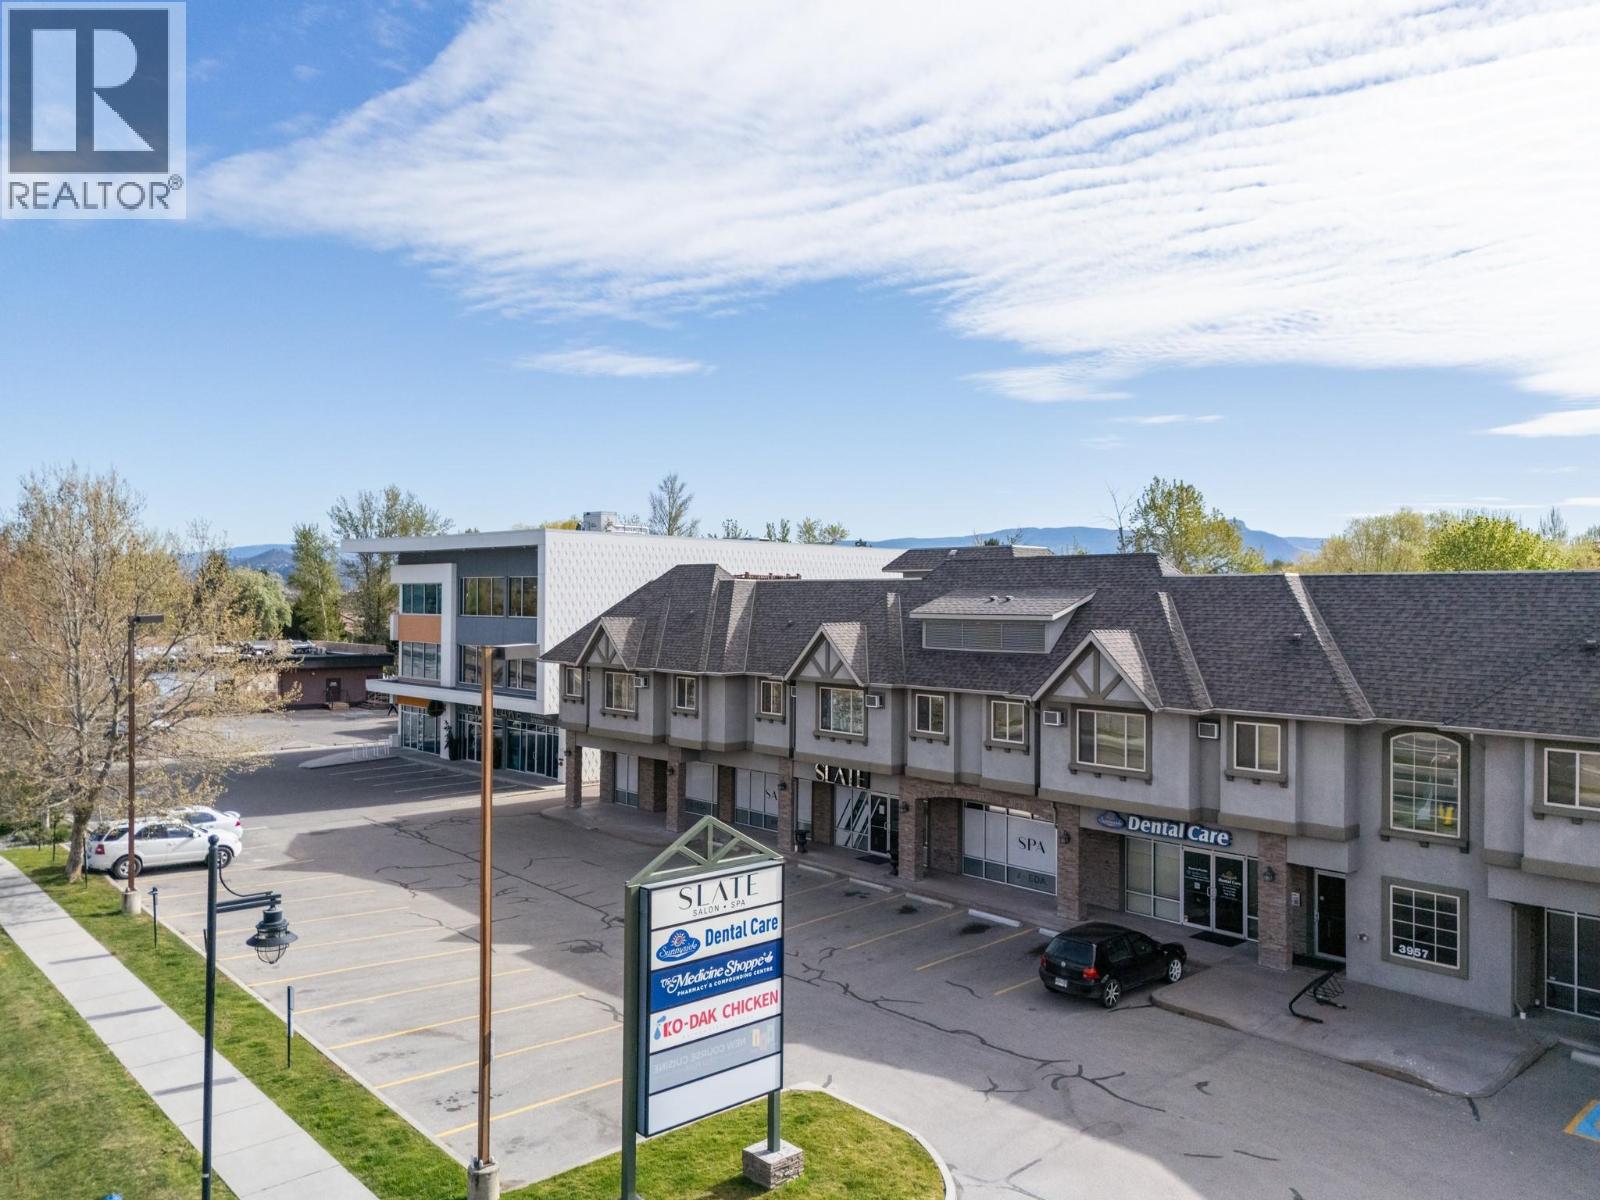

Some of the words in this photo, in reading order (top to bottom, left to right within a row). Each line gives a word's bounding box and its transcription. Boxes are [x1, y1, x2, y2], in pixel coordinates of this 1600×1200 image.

[814, 763, 869, 790] SLATE
[1018, 837, 1046, 854] SPA
[1127, 816, 1185, 838] Dental
[1187, 825, 1230, 846] Care
[678, 873, 759, 910] SLATE
[693, 904, 720, 917] SALON
[731, 899, 746, 909] SPA
[705, 920, 747, 947] Dental
[750, 916, 779, 936] Care
[1398, 944, 1429, 959] 3957
[666, 966, 724, 994] Medicine
[724, 957, 764, 977] Shoppe
[676, 984, 708, 997] PHARMACY
[713, 972, 753, 987] COMPOUNDING
[753, 966, 774, 976] CENTRE
[663, 1007, 717, 1038] KO-DAK
[722, 989, 779, 1019] CHICKEN
